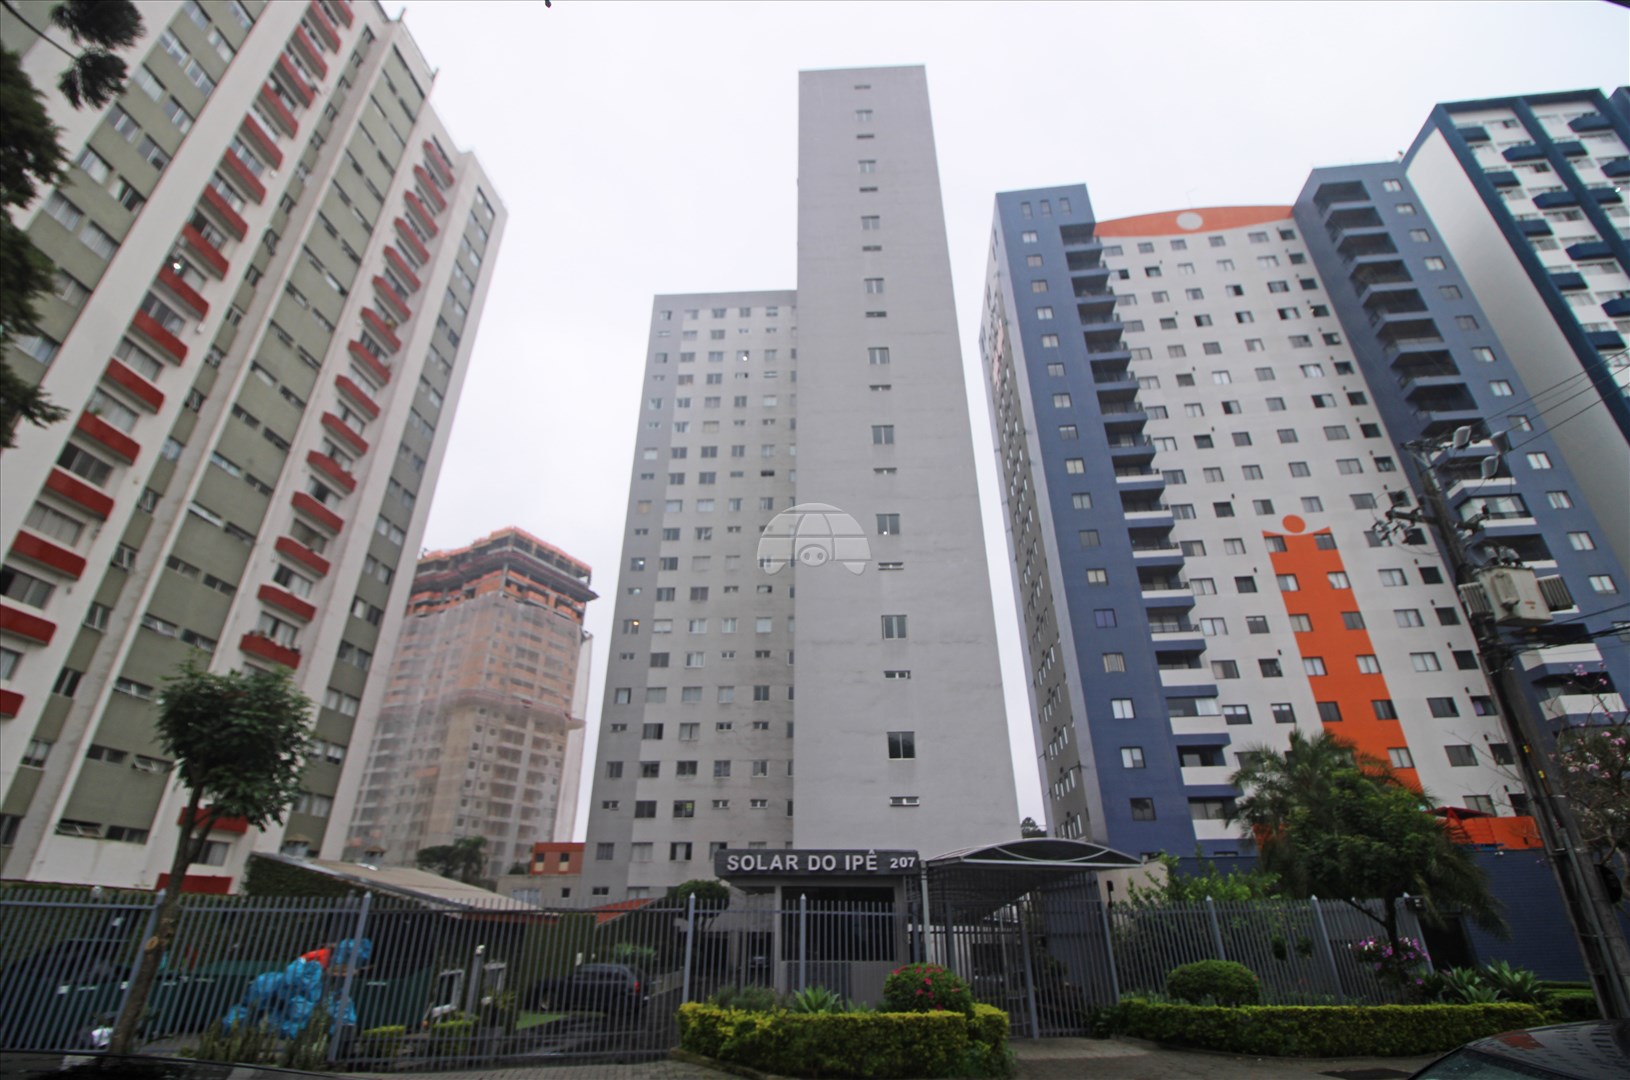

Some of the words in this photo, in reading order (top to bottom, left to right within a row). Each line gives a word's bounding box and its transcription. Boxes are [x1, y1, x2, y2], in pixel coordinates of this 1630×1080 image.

[726, 854, 799, 871] SOLAR
[807, 855, 837, 871] DO
[845, 850, 878, 871] IPÊ
[889, 857, 916, 869] 207
